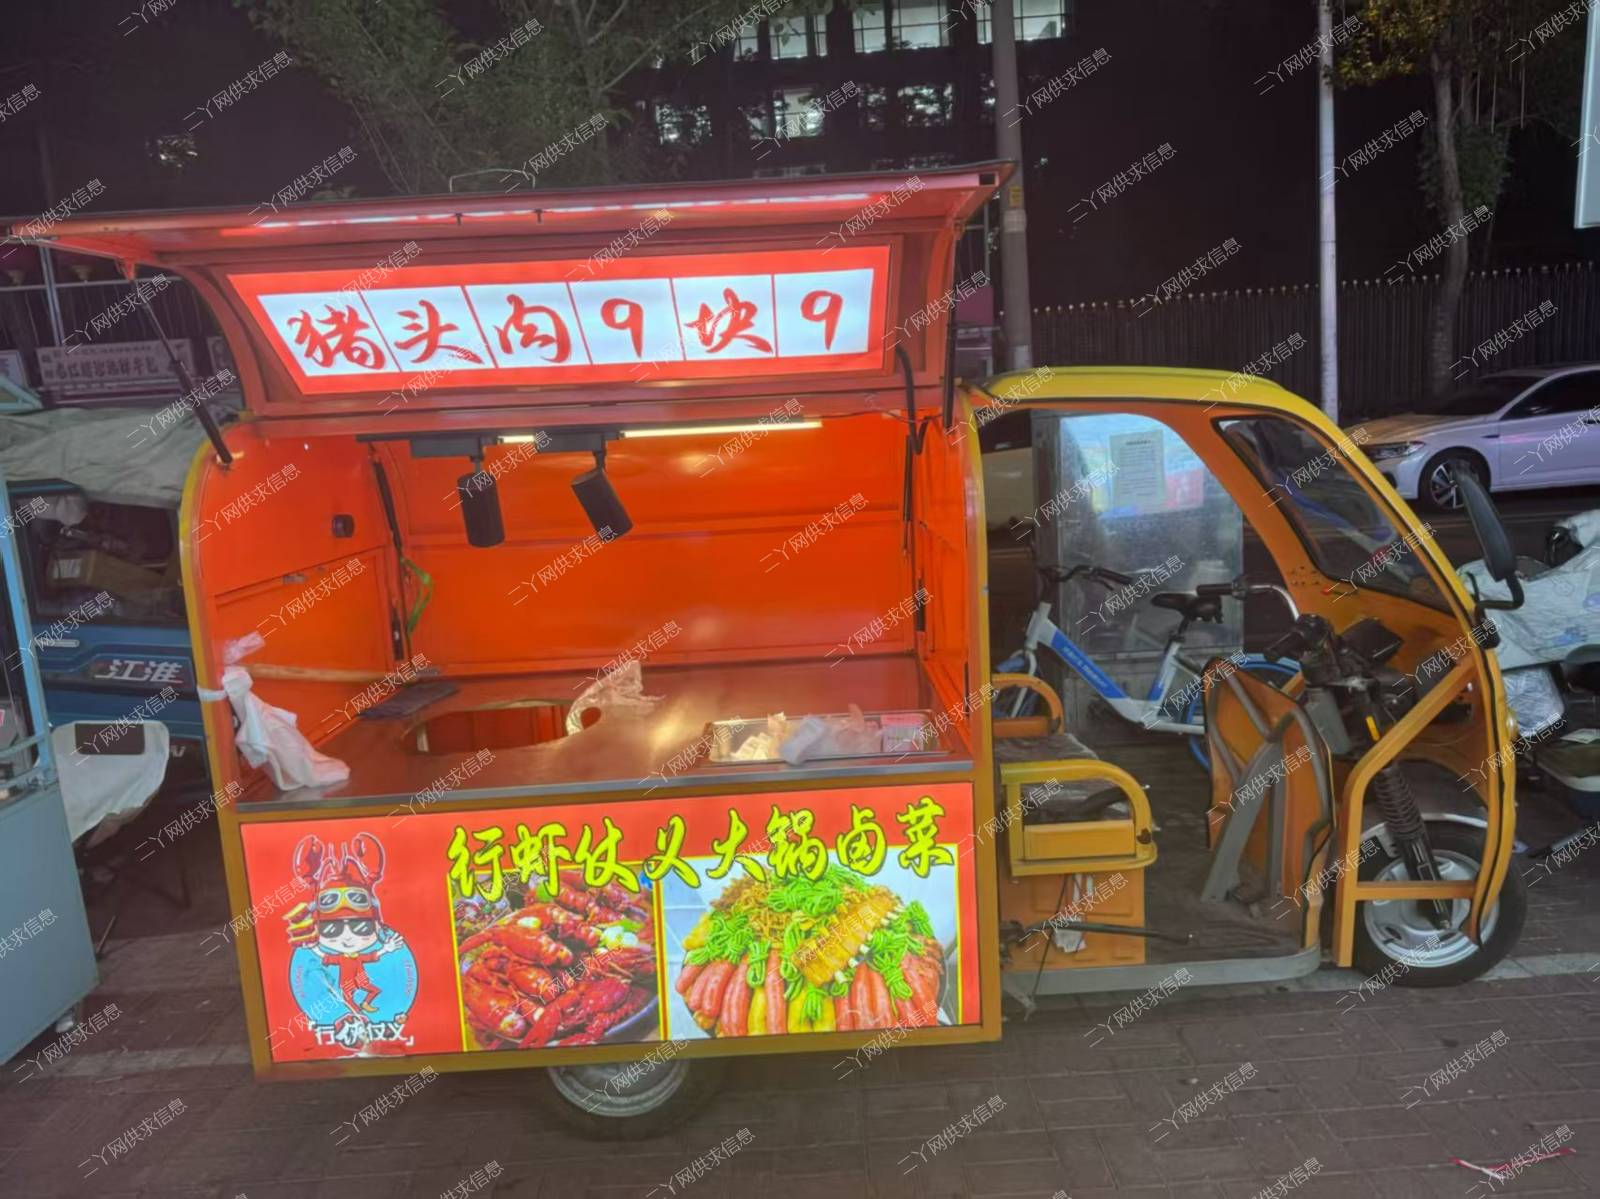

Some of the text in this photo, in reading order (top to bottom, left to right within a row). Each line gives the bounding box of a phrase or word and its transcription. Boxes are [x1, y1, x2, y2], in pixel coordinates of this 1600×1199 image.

[287, 288, 843, 370] 猪头肉9块9
[95, 659, 183, 684] 江淮
[447, 795, 955, 902] 行虾仗义大锅卤菜
